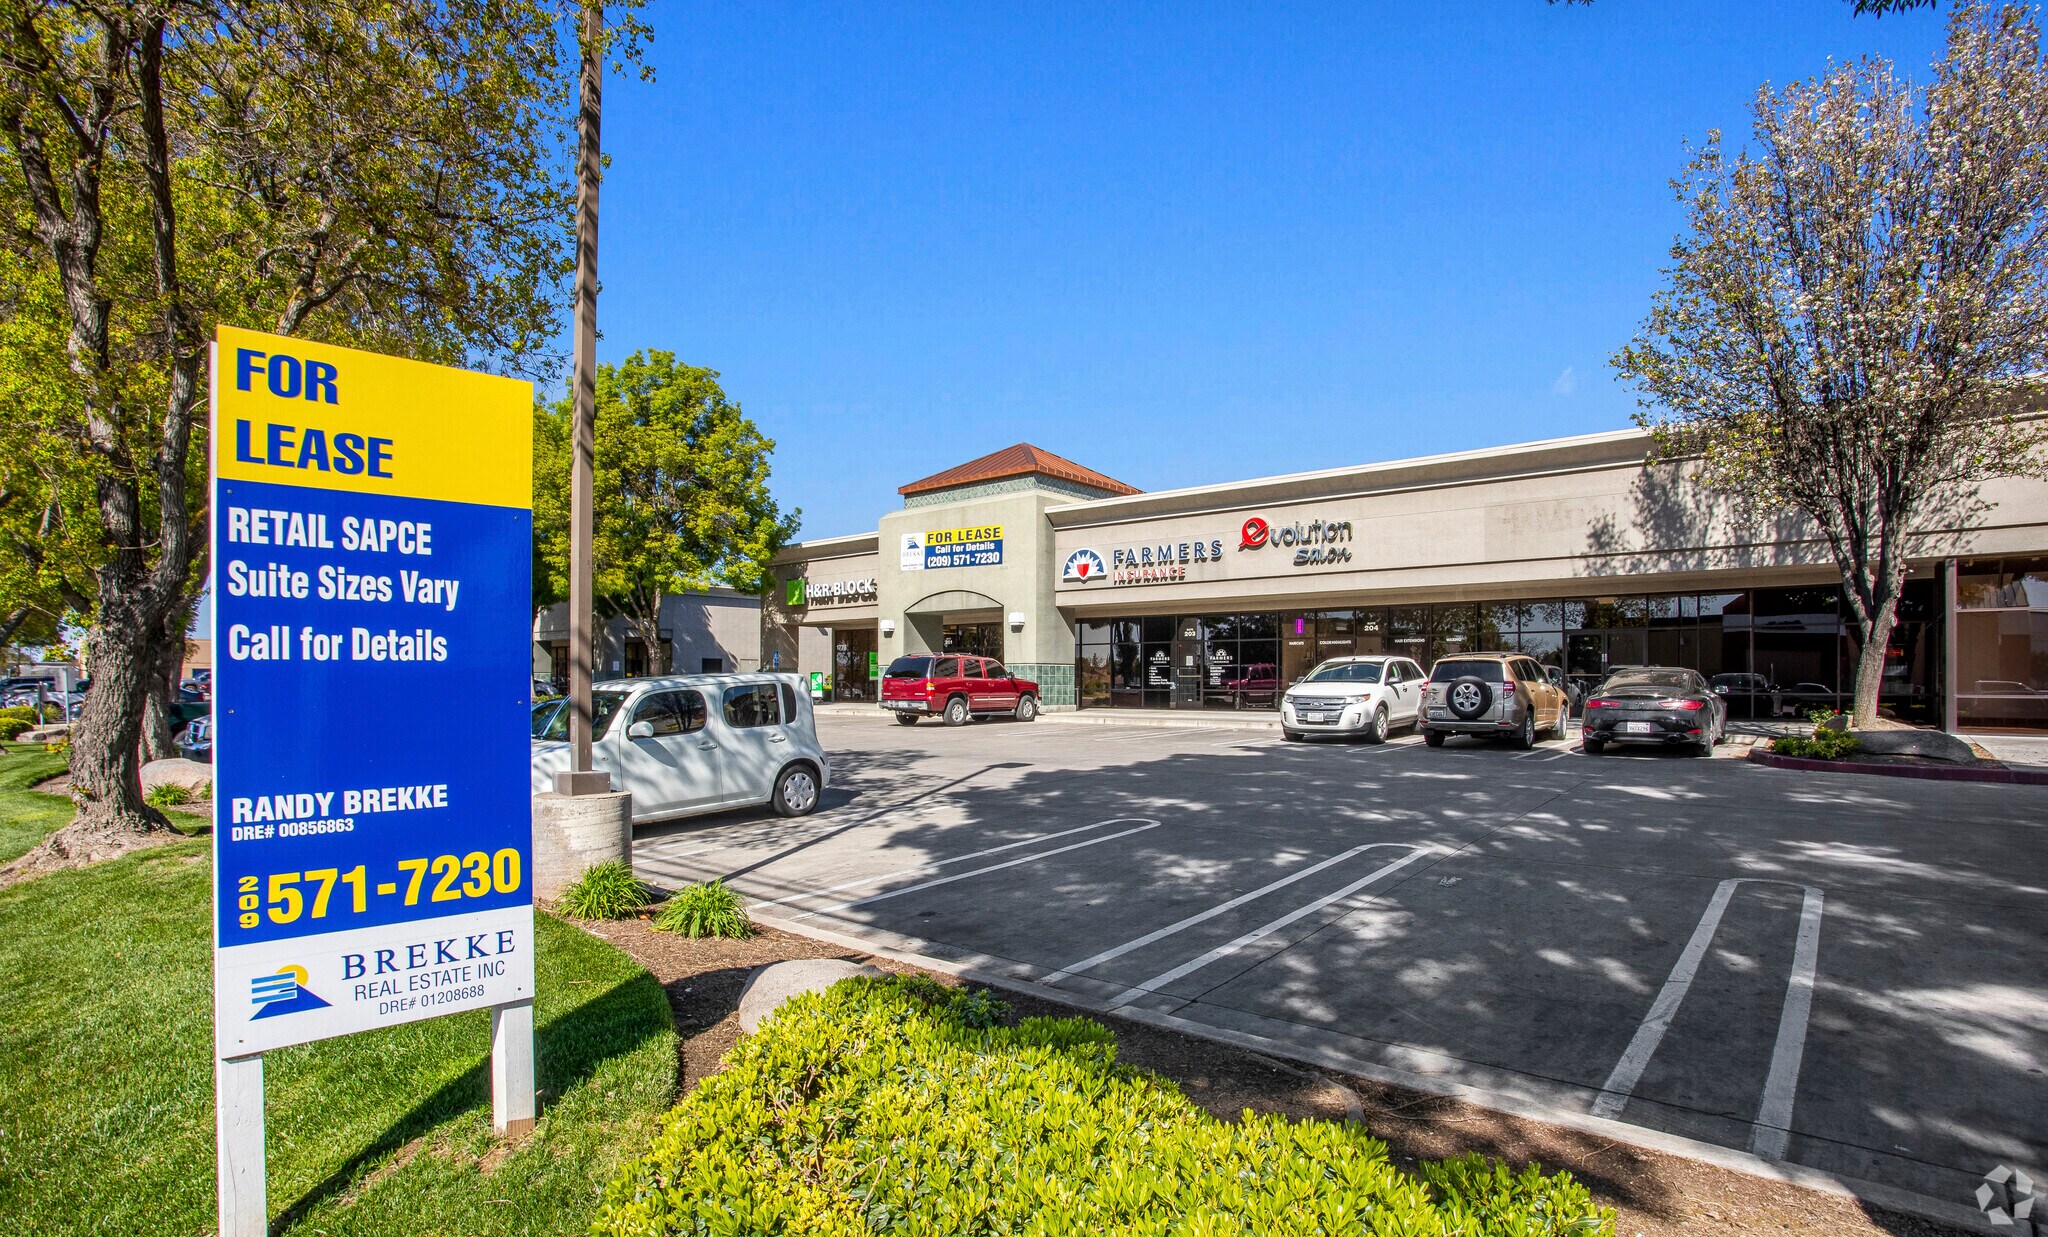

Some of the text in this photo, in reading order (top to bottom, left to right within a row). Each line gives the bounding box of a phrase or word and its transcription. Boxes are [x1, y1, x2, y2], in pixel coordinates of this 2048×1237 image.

[236, 347, 339, 405] FOR
[236, 418, 393, 479] LEASE
[228, 506, 432, 555] RETAIL SAPCE
[927, 527, 1001, 544] FOR LEASE
[935, 542, 995, 554] Call for Details
[927, 555, 951, 568] (209)
[953, 552, 1000, 565] 571-7230
[1113, 540, 1222, 565] FARMERS
[228, 559, 459, 611] Suite Sizes Vary
[806, 579, 876, 599] H&R BLOCK
[1113, 566, 1186, 581] INSURANCE
[229, 623, 448, 662] Call for Details
[231, 784, 448, 824] RANDY BREKKE
[231, 817, 354, 842] DRE# 00856863
[238, 875, 260, 929] 209
[267, 847, 521, 924] 571-7230
[341, 929, 516, 981] BREKKE
[354, 959, 505, 1001] REAL ESTATE INC
[379, 984, 485, 1015] DRE# 01208688
